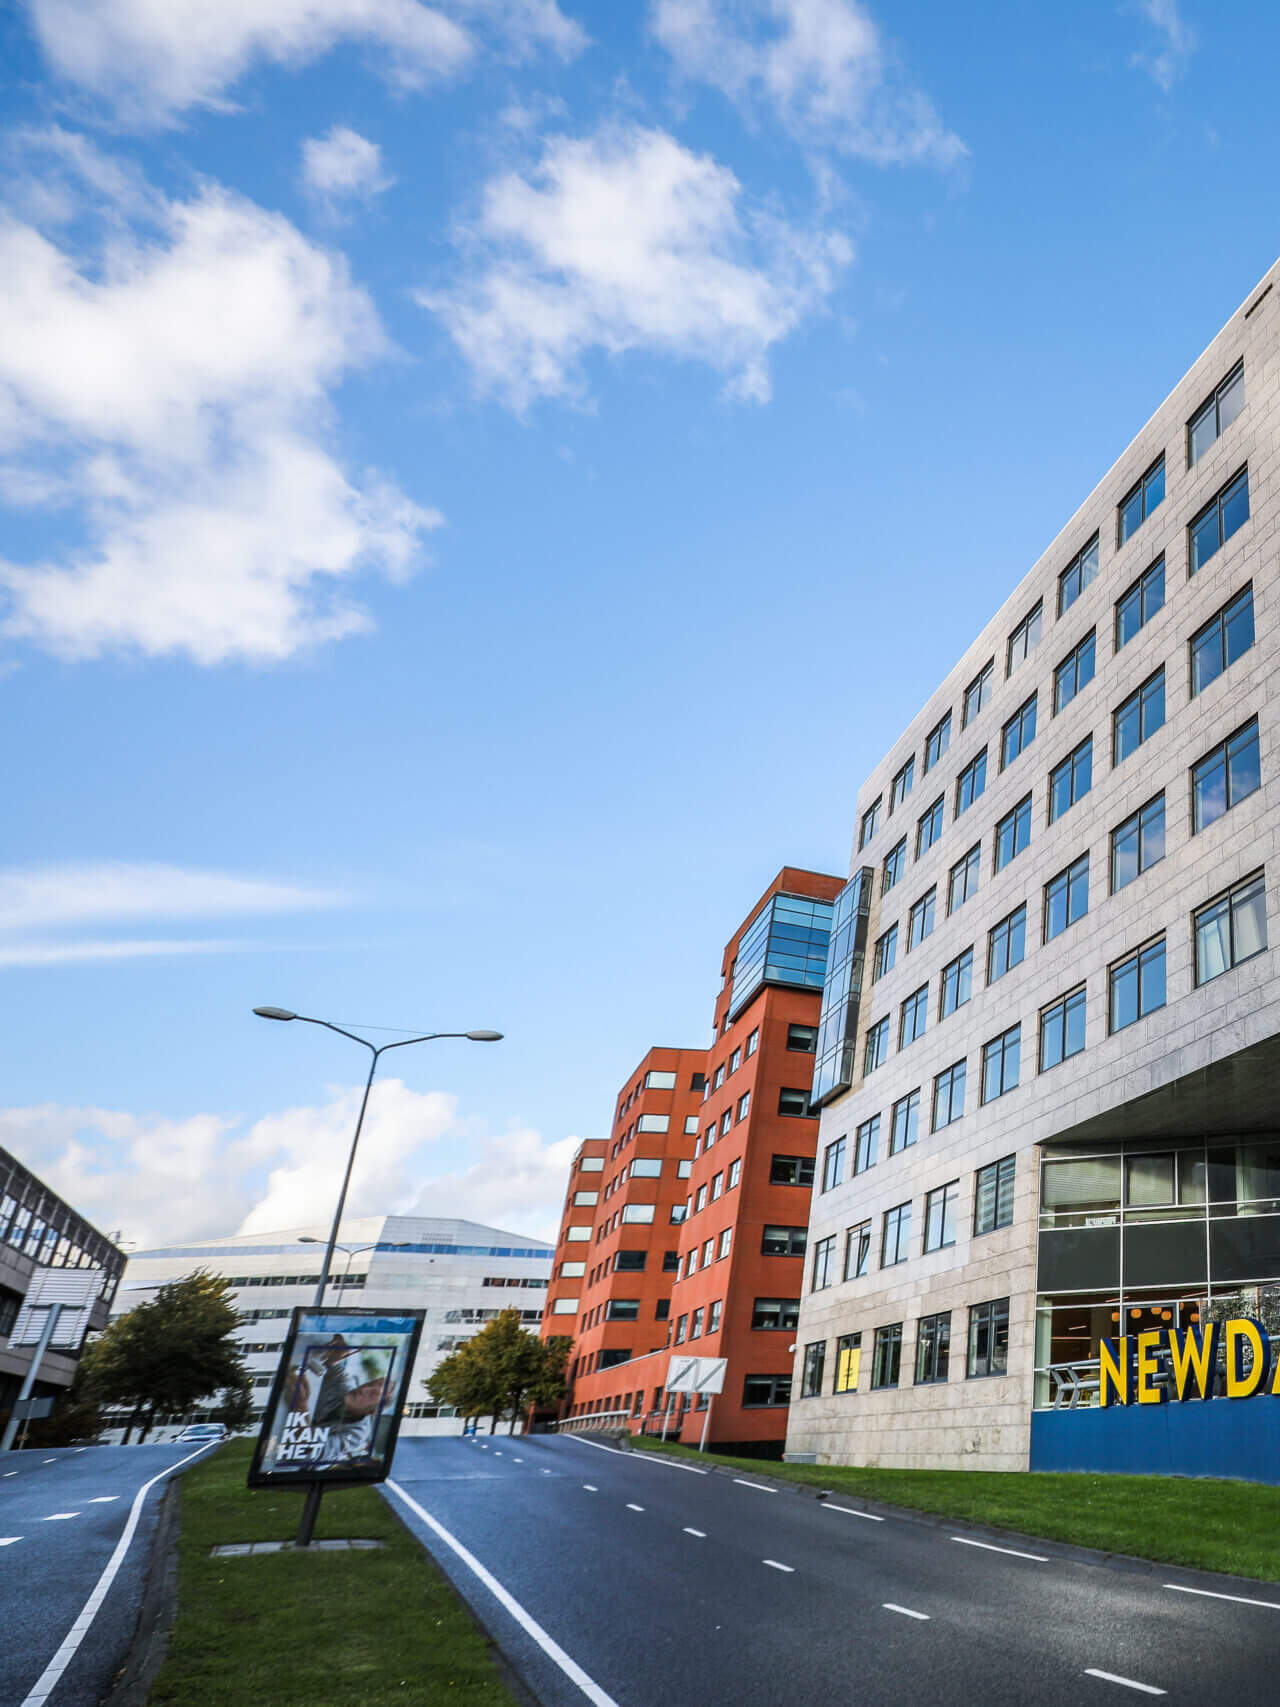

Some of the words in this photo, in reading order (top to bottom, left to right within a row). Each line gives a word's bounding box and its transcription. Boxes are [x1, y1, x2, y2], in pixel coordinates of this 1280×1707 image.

[285, 1411, 310, 1427] IK
[281, 1427, 331, 1444] KAN
[276, 1443, 323, 1461] HET
